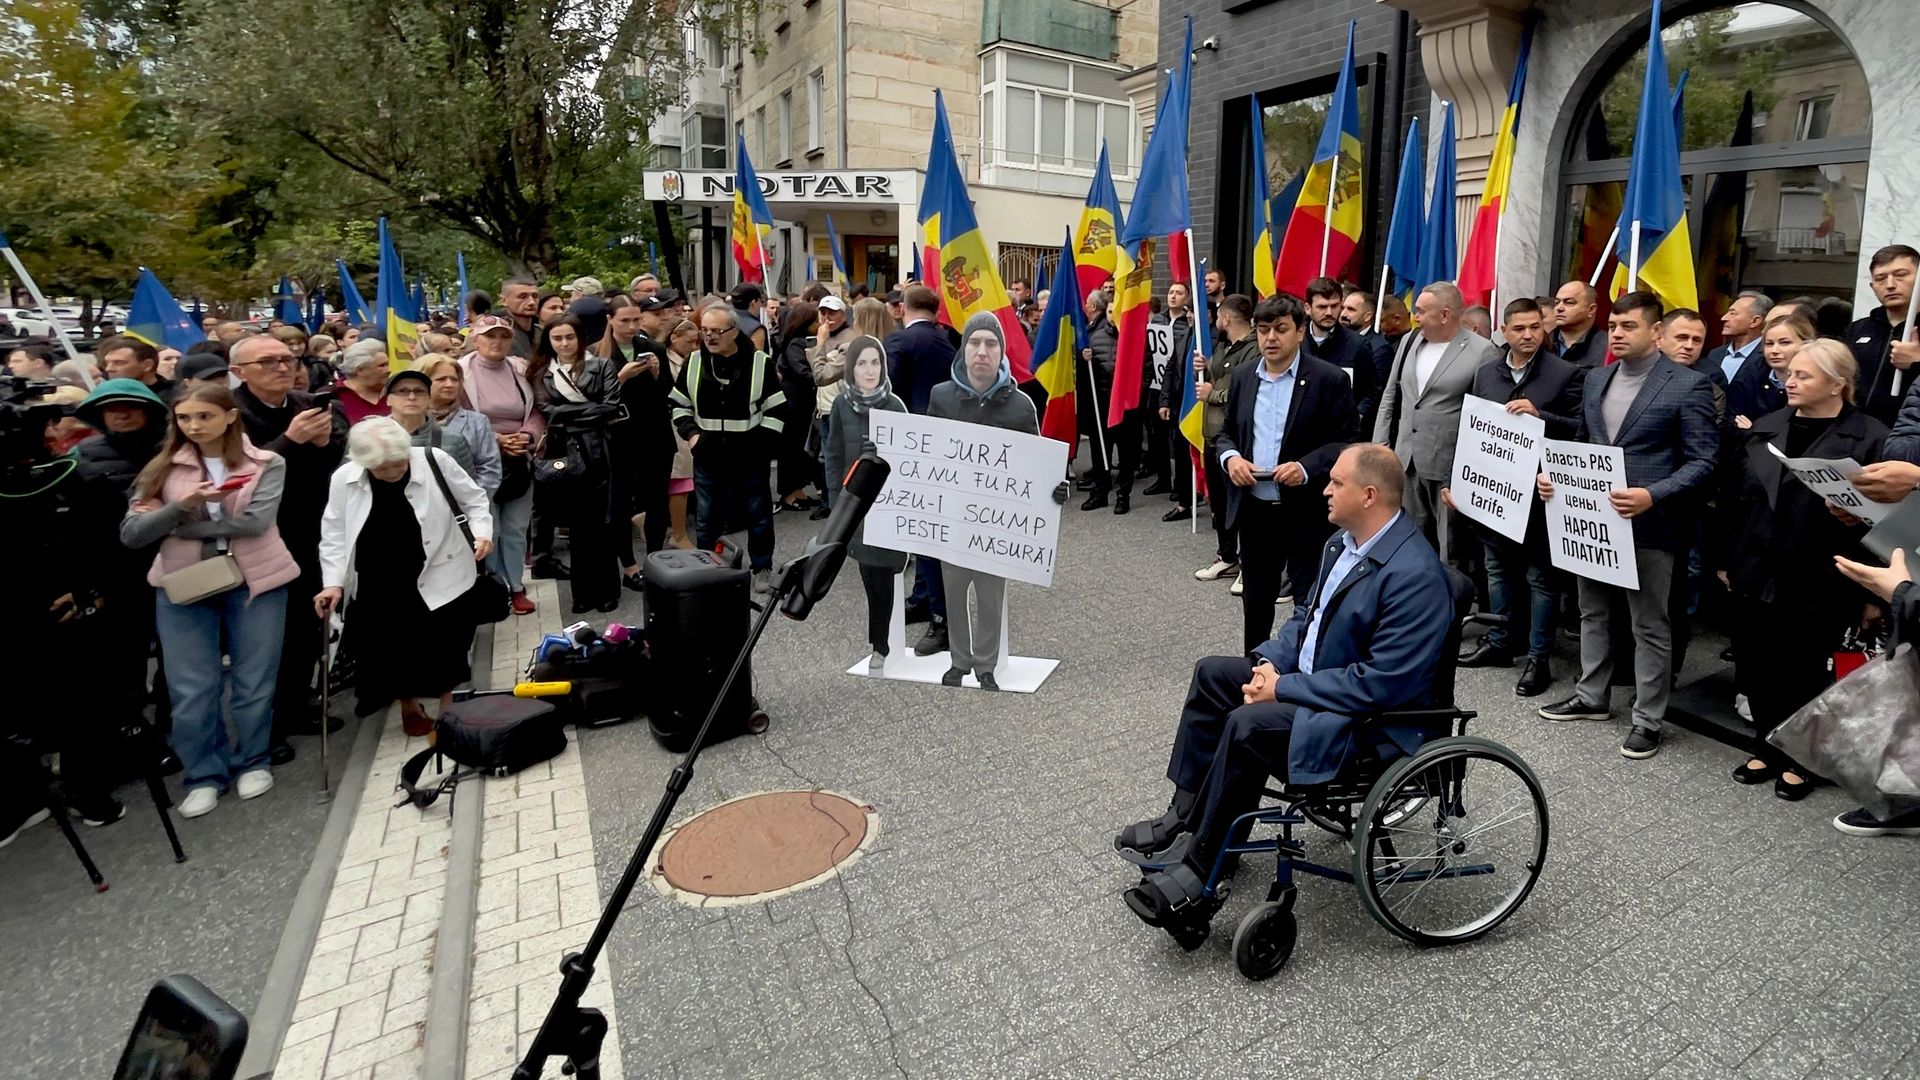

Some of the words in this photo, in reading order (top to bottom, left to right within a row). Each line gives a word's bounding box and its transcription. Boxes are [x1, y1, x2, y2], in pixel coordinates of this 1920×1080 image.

[702, 175, 893, 197] NOTAR
[876, 425, 894, 446] EI
[904, 431, 933, 454] SE
[944, 437, 1013, 470] JURĂ
[1470, 414, 1535, 450] Verișoarelor
[1480, 440, 1516, 464] salarii.
[1545, 447, 1587, 469] Власть
[1589, 453, 1613, 473] PAS
[899, 460, 921, 480] CĂ
[927, 465, 959, 485] NU
[973, 471, 1033, 500] FURĂ
[1461, 464, 1524, 504] Oamenilor
[1549, 471, 1613, 493] повышает
[1470, 490, 1506, 520] tarife.
[1565, 493, 1602, 513] цены.
[963, 503, 1047, 537] SCUMP
[1563, 514, 1611, 546] НАРОД
[895, 515, 951, 543] PESTE
[967, 533, 1054, 573] MĂSURĂ!
[1561, 537, 1620, 570] ПЛАТИТ!
